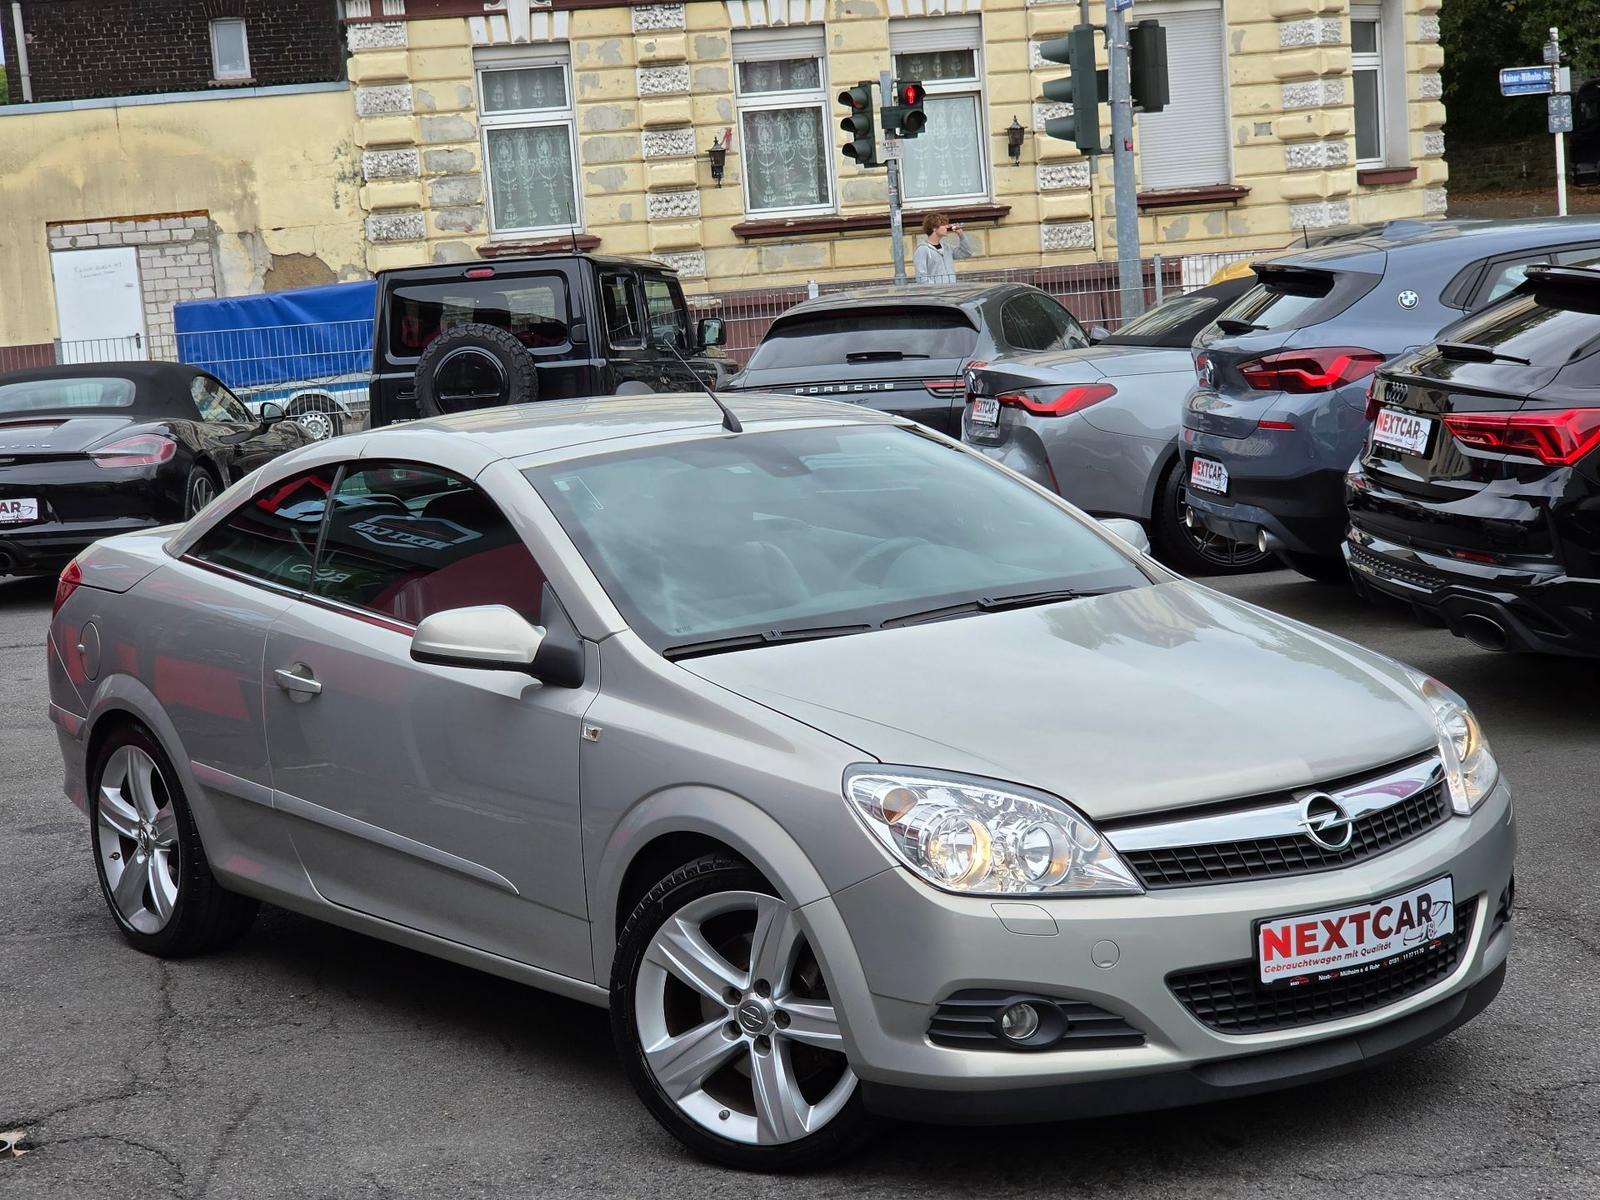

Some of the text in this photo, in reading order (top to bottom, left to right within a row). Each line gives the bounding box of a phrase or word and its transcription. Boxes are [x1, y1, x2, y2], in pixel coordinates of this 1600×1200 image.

[795, 383, 894, 394] PORSCHE
[1376, 411, 1420, 440] NEXTCAR
[1193, 460, 1222, 481] NEXTCAR
[1262, 892, 1432, 962] NEXTCAR
[1264, 942, 1391, 973] Gebrauchtwagen mit Qualität
